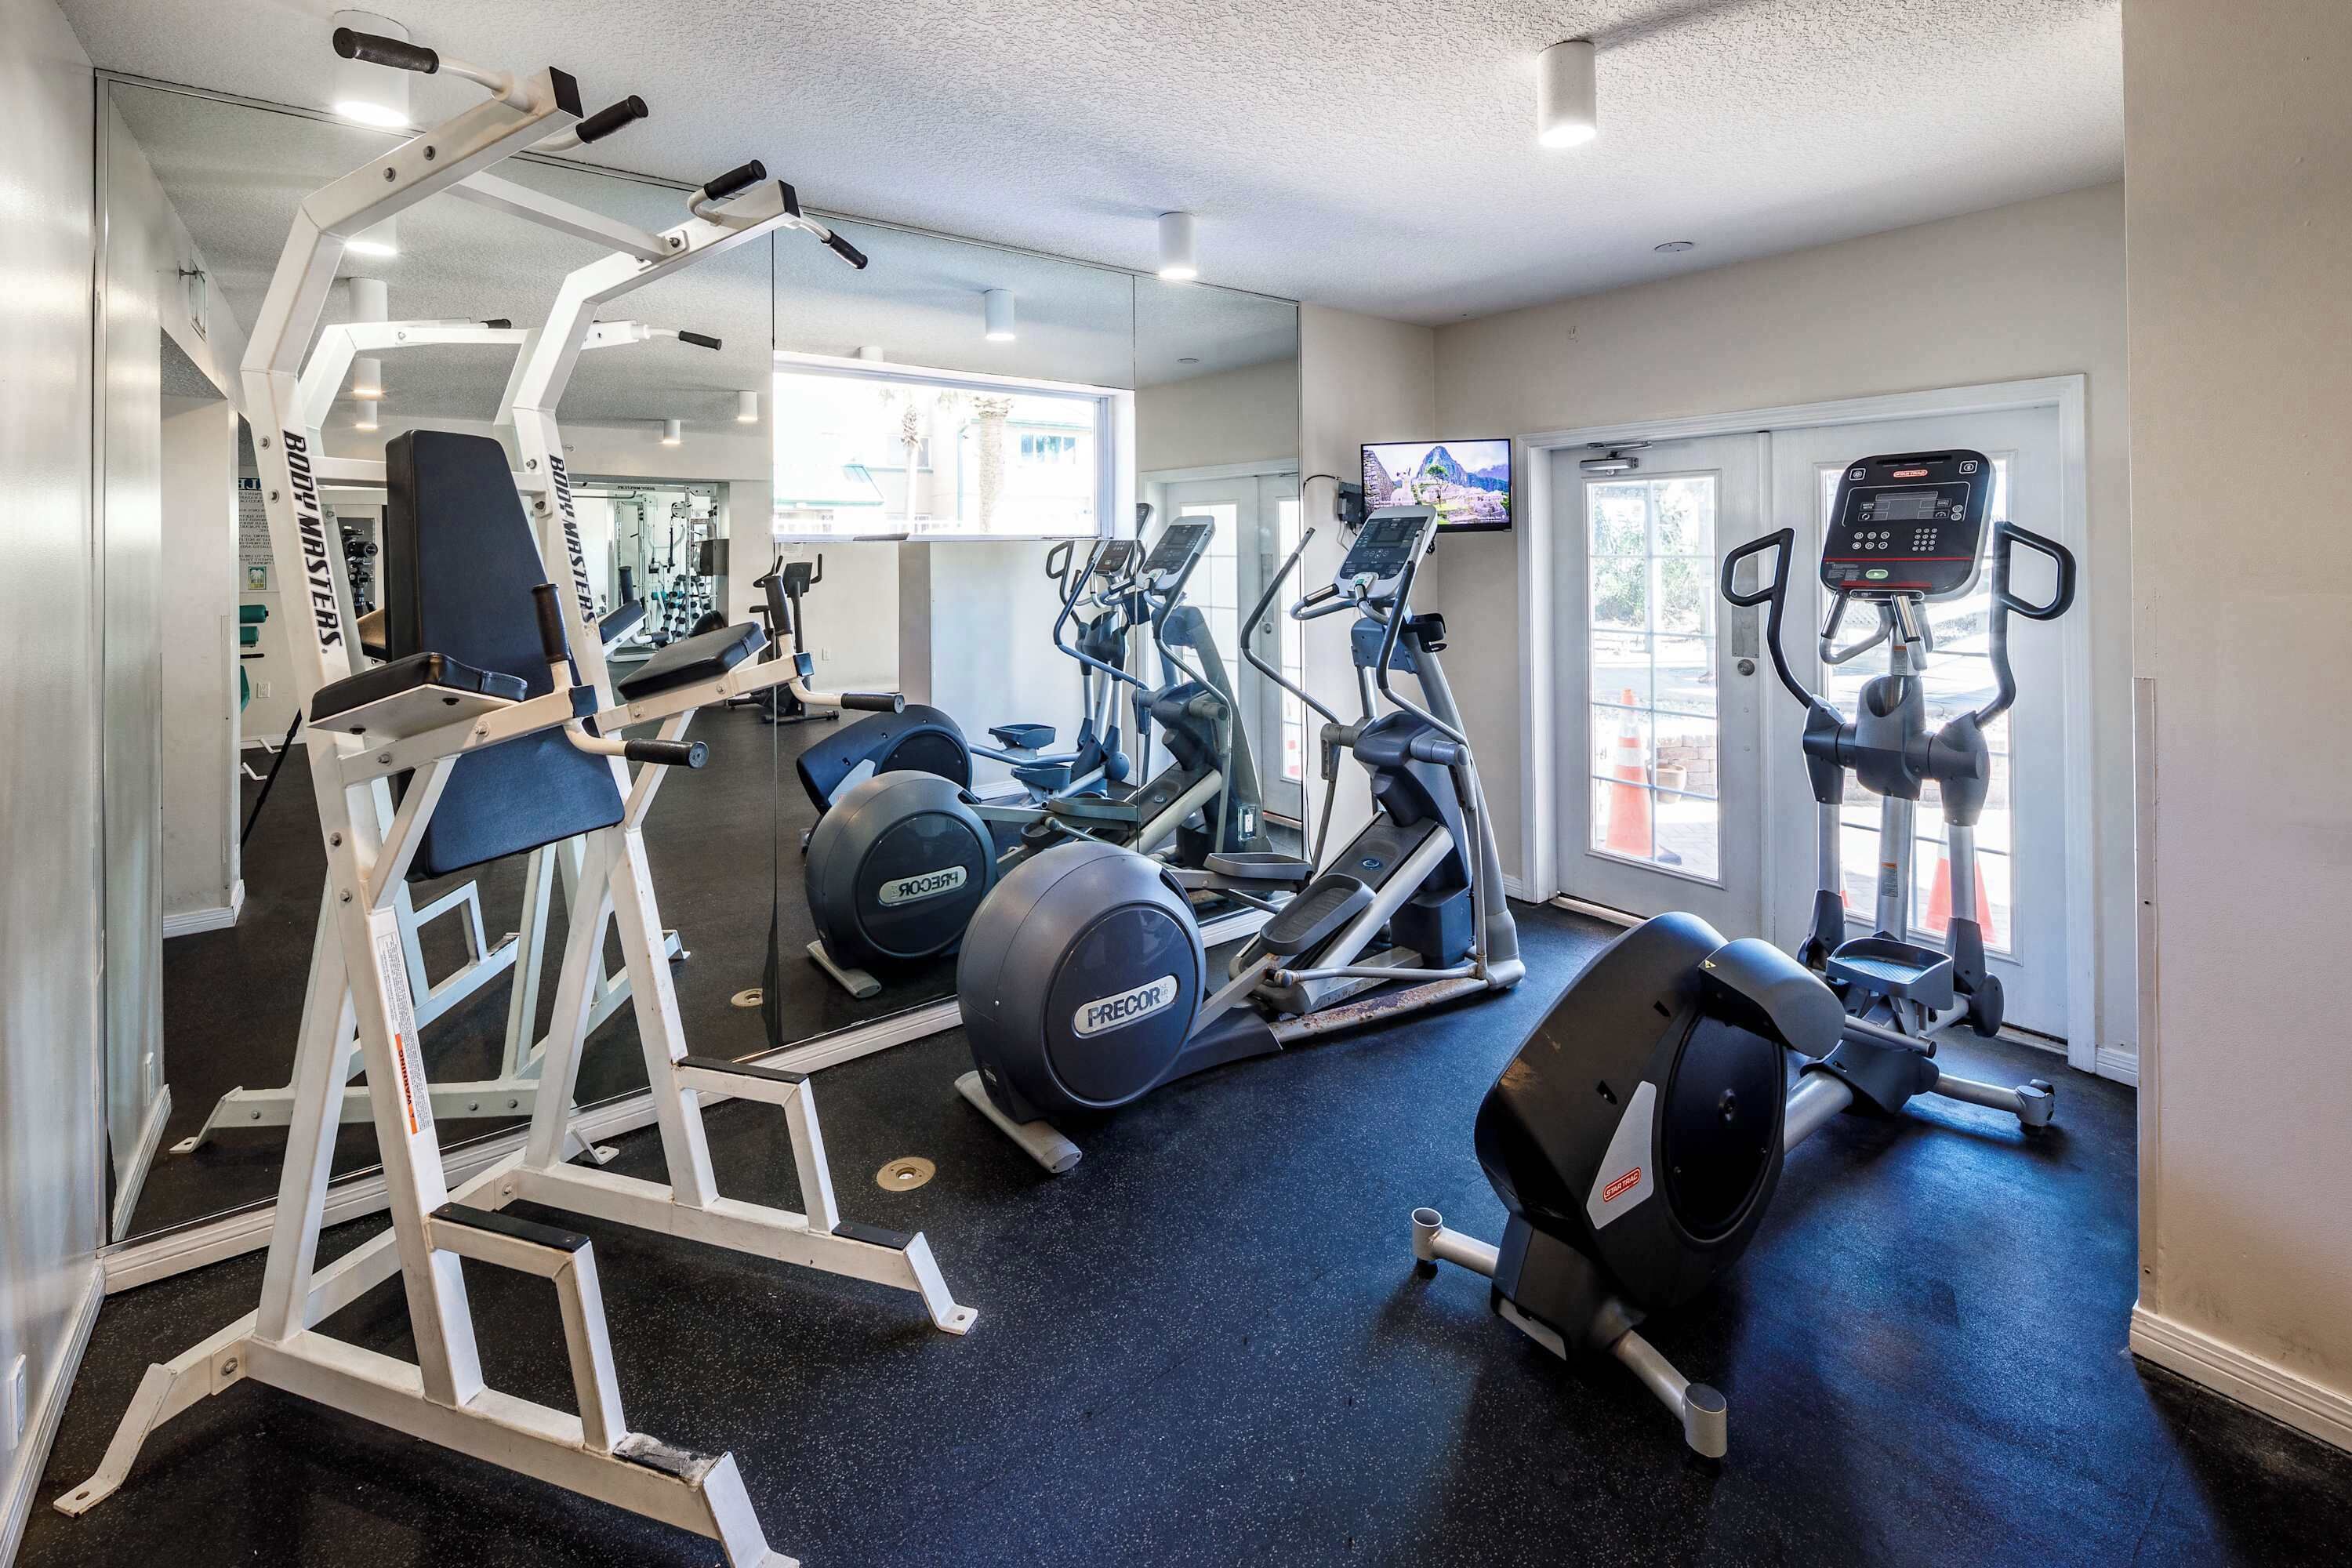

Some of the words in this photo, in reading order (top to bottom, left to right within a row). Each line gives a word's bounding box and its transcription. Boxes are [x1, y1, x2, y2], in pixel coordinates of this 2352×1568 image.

[282, 430, 319, 512] BODY
[550, 453, 575, 519] BODY
[297, 512, 343, 647] MASTERS
[562, 518, 597, 624] MASTERS
[1087, 986, 1161, 1028] PRECOR
[398, 1050, 412, 1105] WARNING
[1606, 1182, 1622, 1196] STAR
[1622, 1172, 1639, 1187] TRAC
